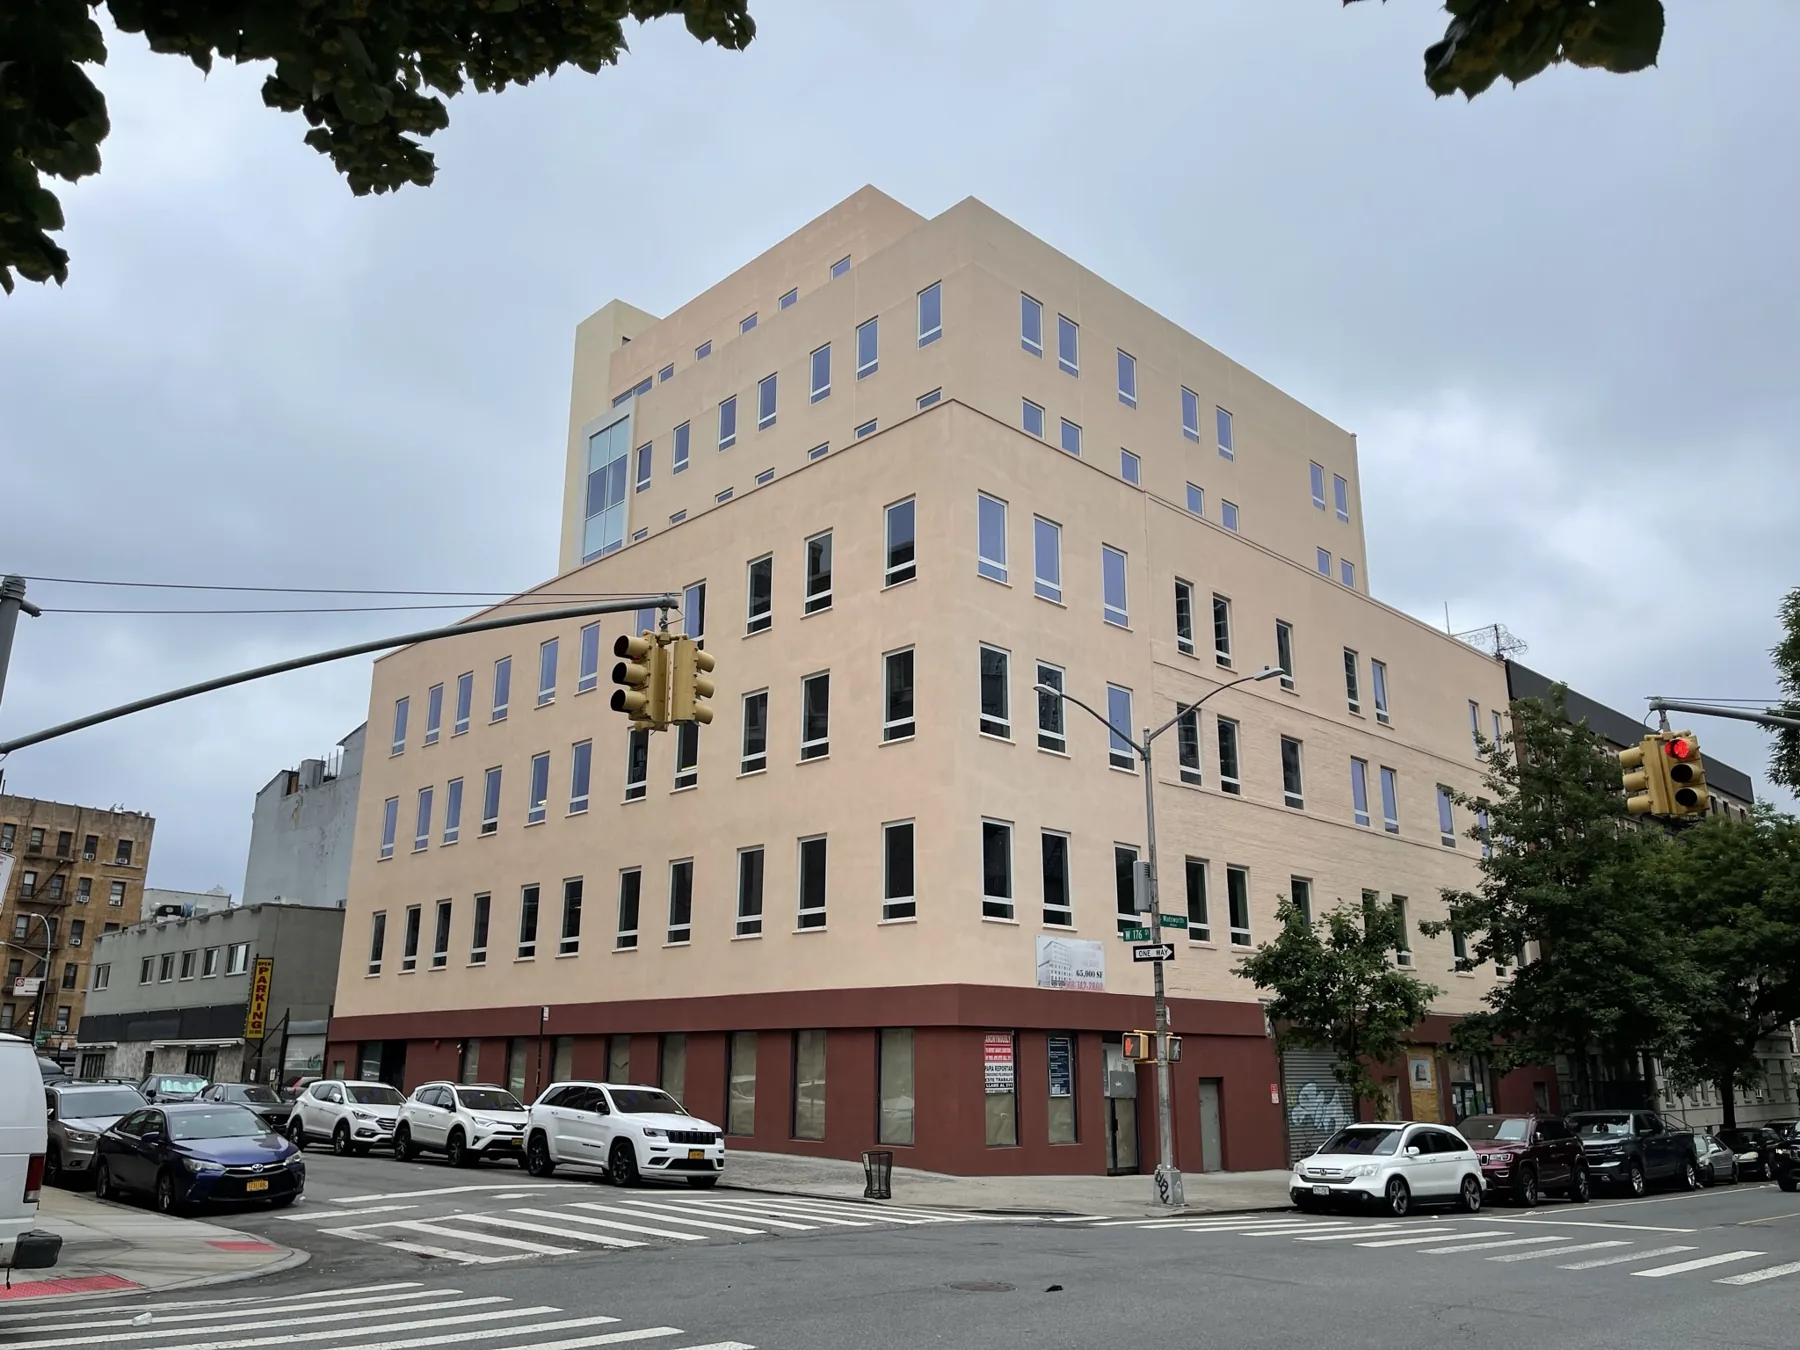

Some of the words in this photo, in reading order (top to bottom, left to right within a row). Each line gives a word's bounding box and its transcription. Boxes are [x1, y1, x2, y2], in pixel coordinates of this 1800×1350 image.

[1125, 930, 1131, 940] W
[1133, 930, 1143, 940] 176
[1075, 969, 1096, 978] 65,000
[251, 967, 269, 1029] PARKING
